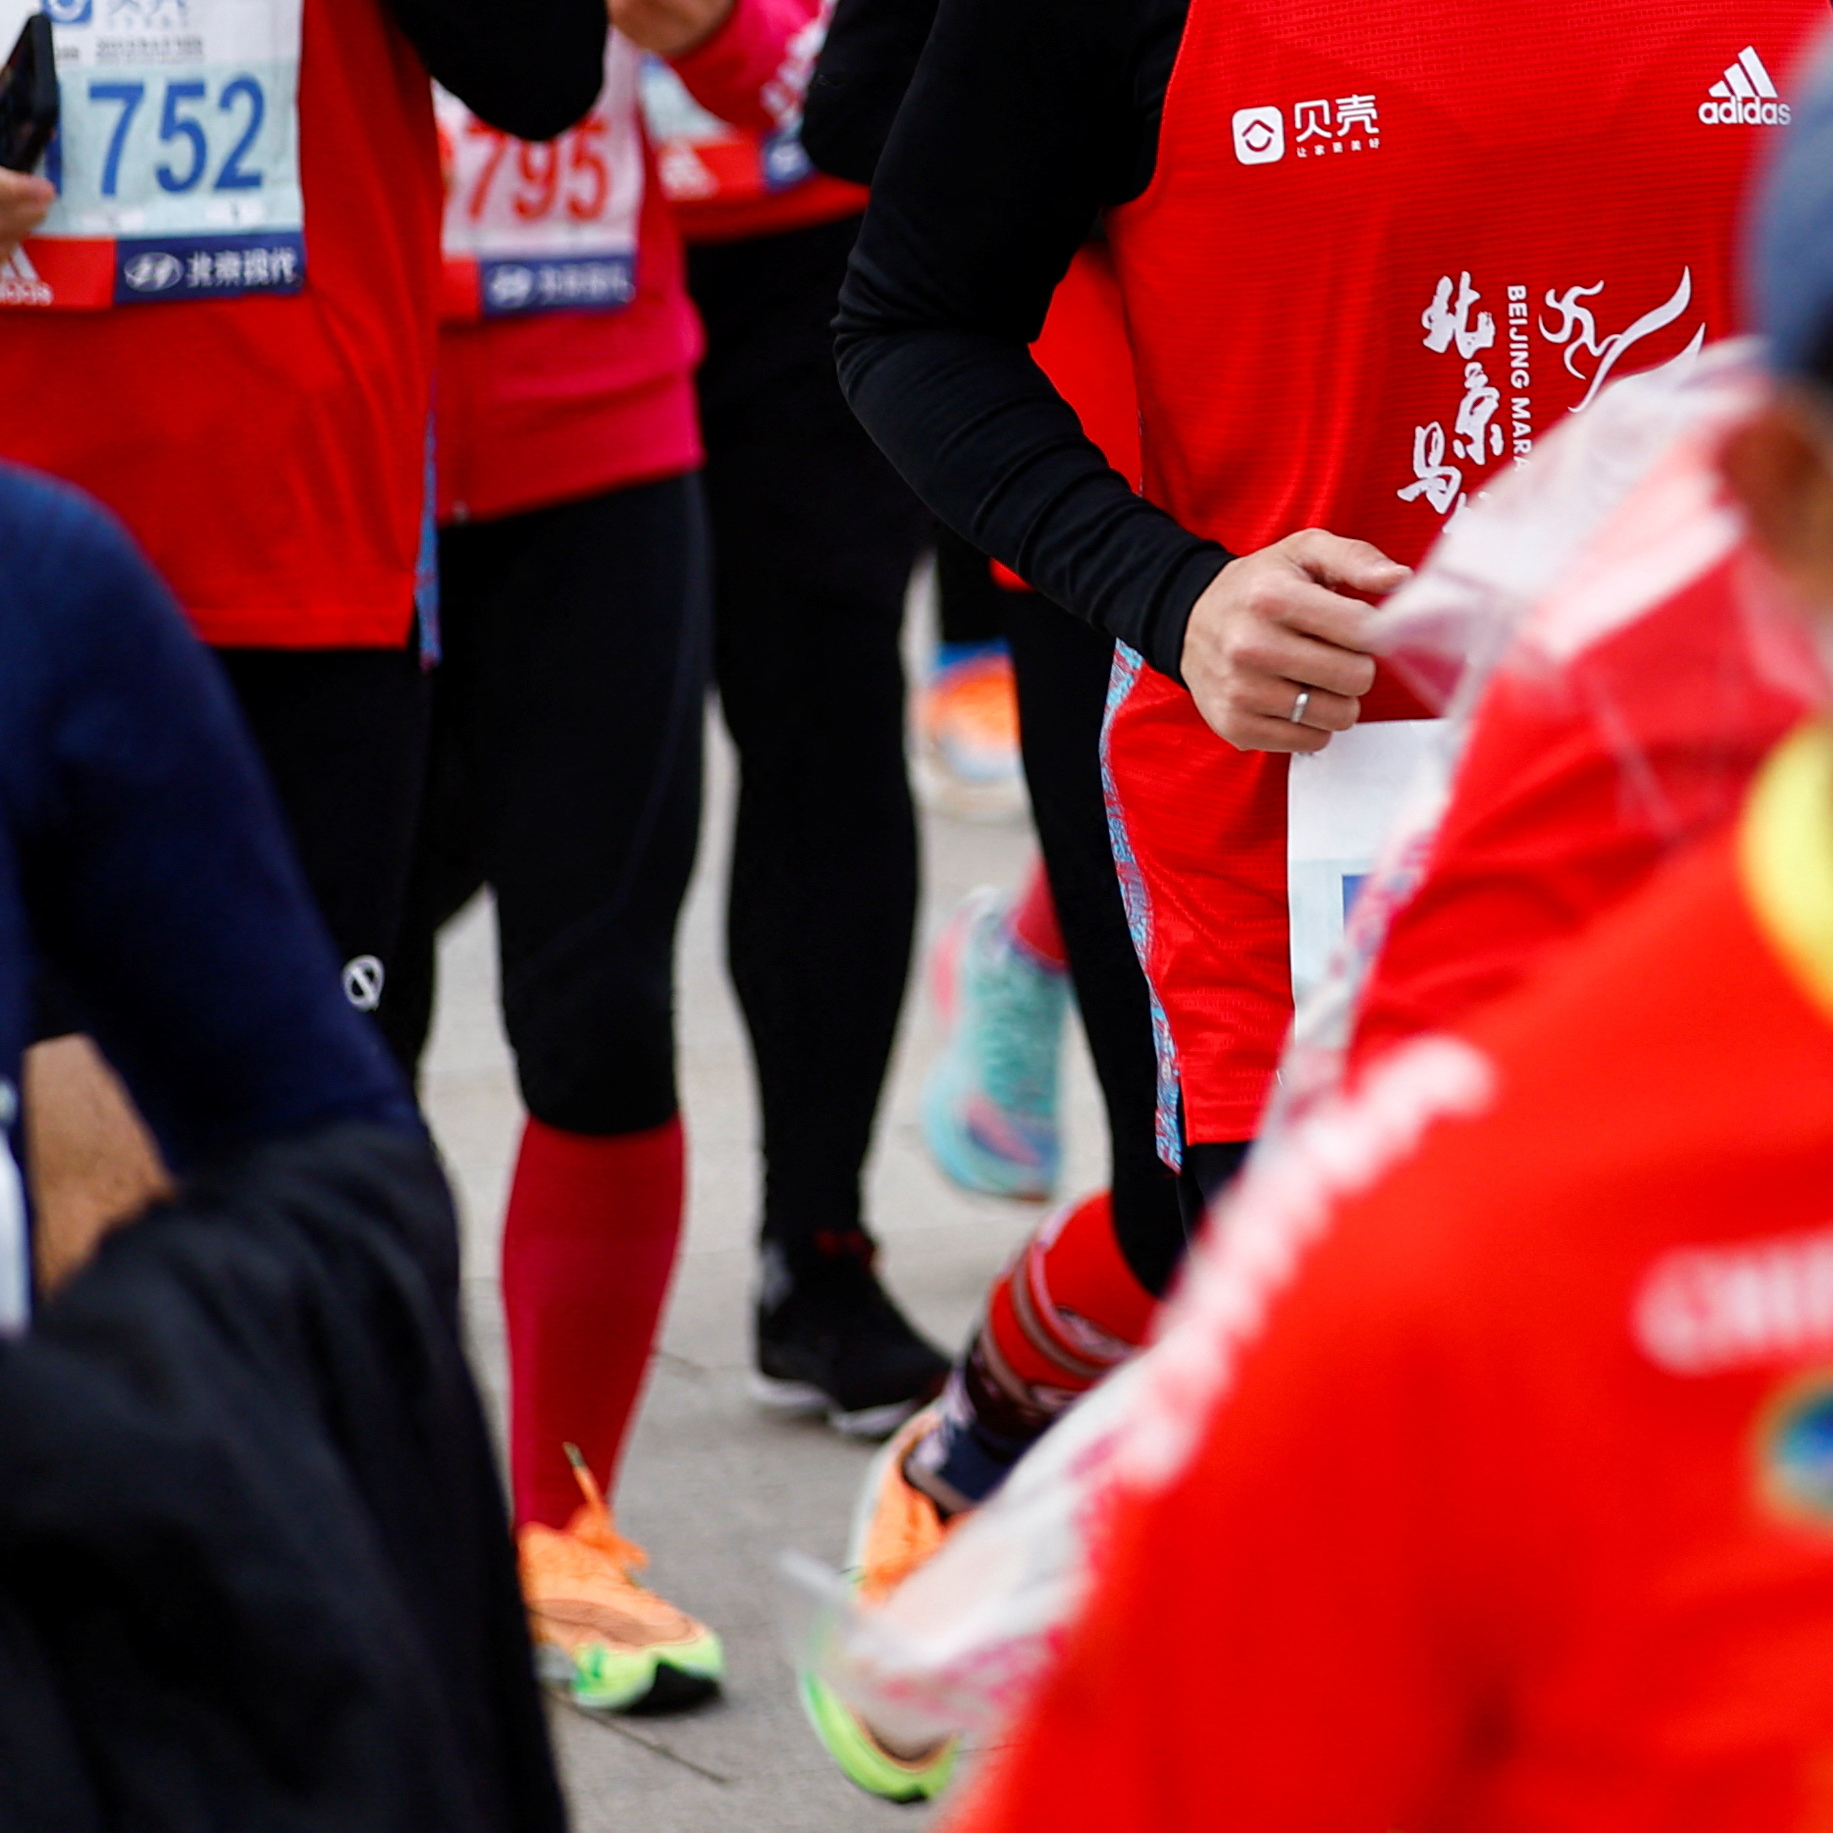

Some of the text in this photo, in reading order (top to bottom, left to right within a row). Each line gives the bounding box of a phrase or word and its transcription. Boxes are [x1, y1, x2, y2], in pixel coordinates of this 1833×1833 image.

[46, 74, 265, 200] 752
[1294, 94, 1380, 143] 贝壳
[1698, 95, 1792, 125] adidas
[1507, 284, 1530, 389] BEIJING
